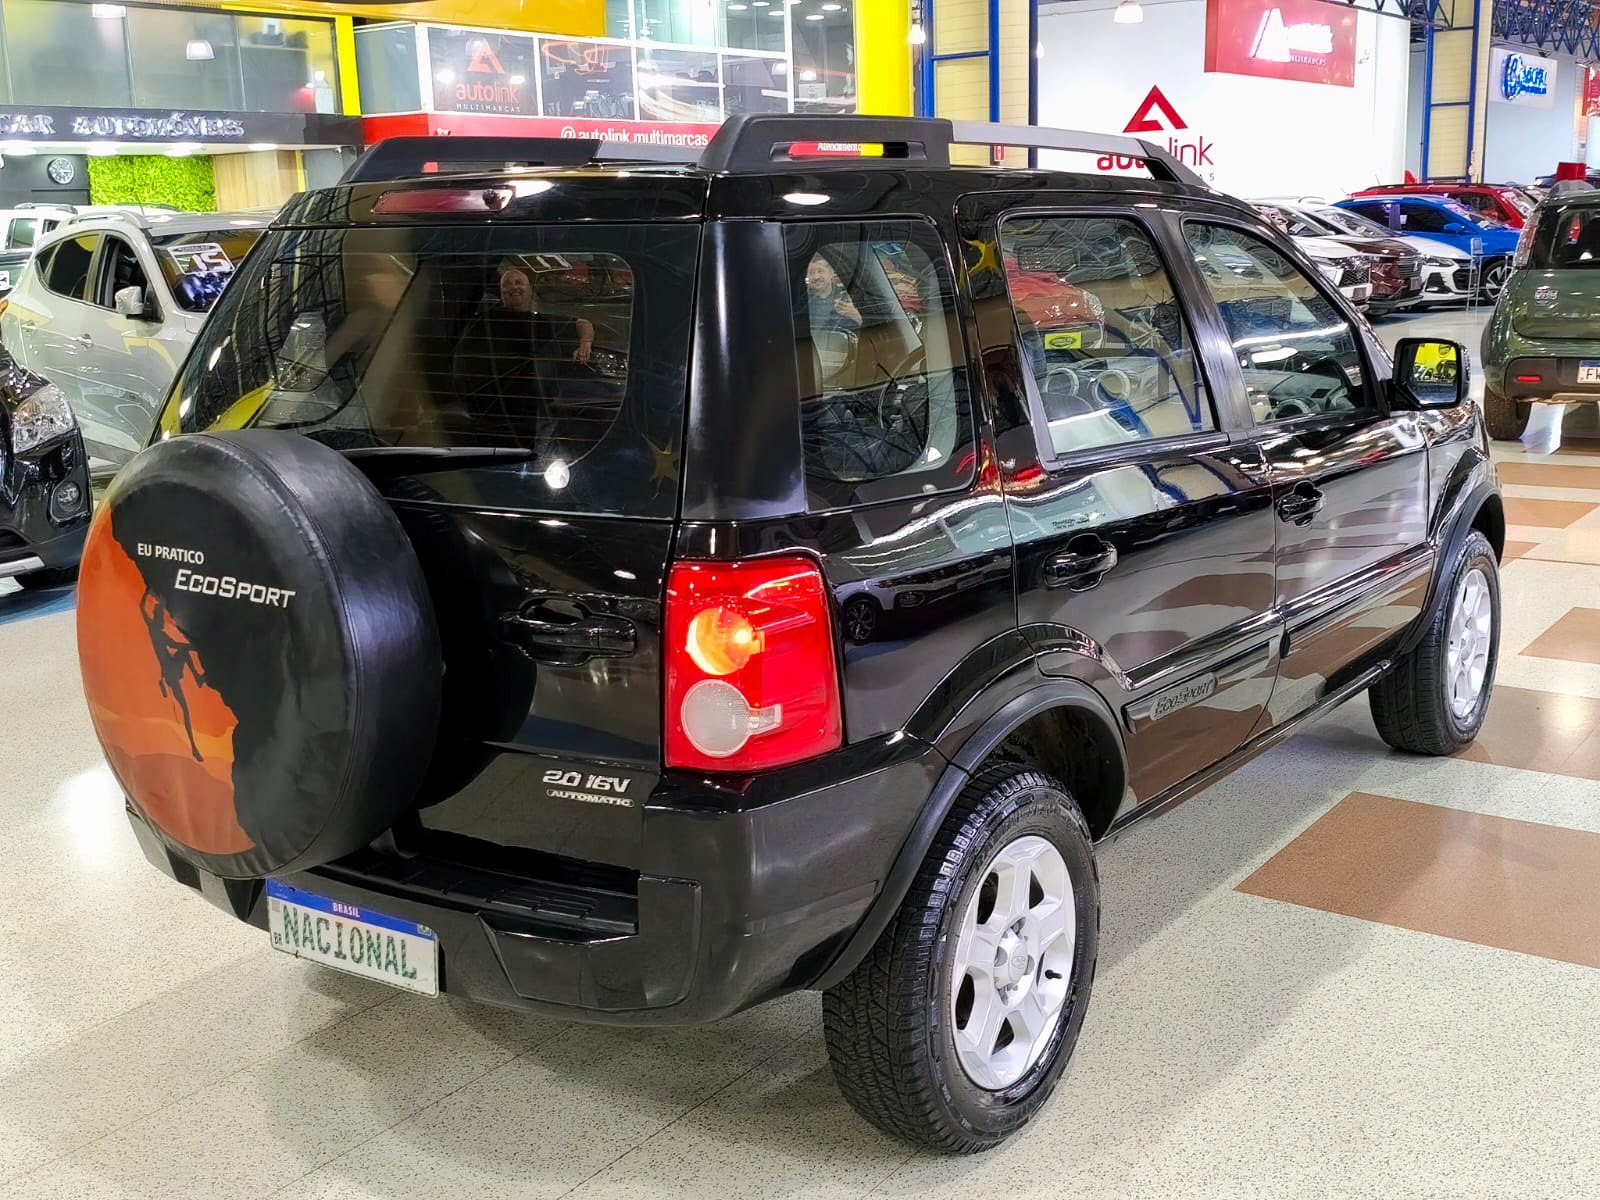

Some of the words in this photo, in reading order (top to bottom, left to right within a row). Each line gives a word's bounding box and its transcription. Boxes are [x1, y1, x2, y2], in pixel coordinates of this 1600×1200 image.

[456, 81, 519, 104] autolink
[456, 103, 521, 112] MULTIMARCAS
[137, 543, 152, 557] EU
[155, 545, 204, 564] PRATICO
[585, 774, 631, 793] 16V
[549, 789, 634, 807] AUTOMATIC
[332, 901, 361, 919] BRASIL
[273, 931, 284, 947] BR
[282, 904, 418, 981] NACIONAL
